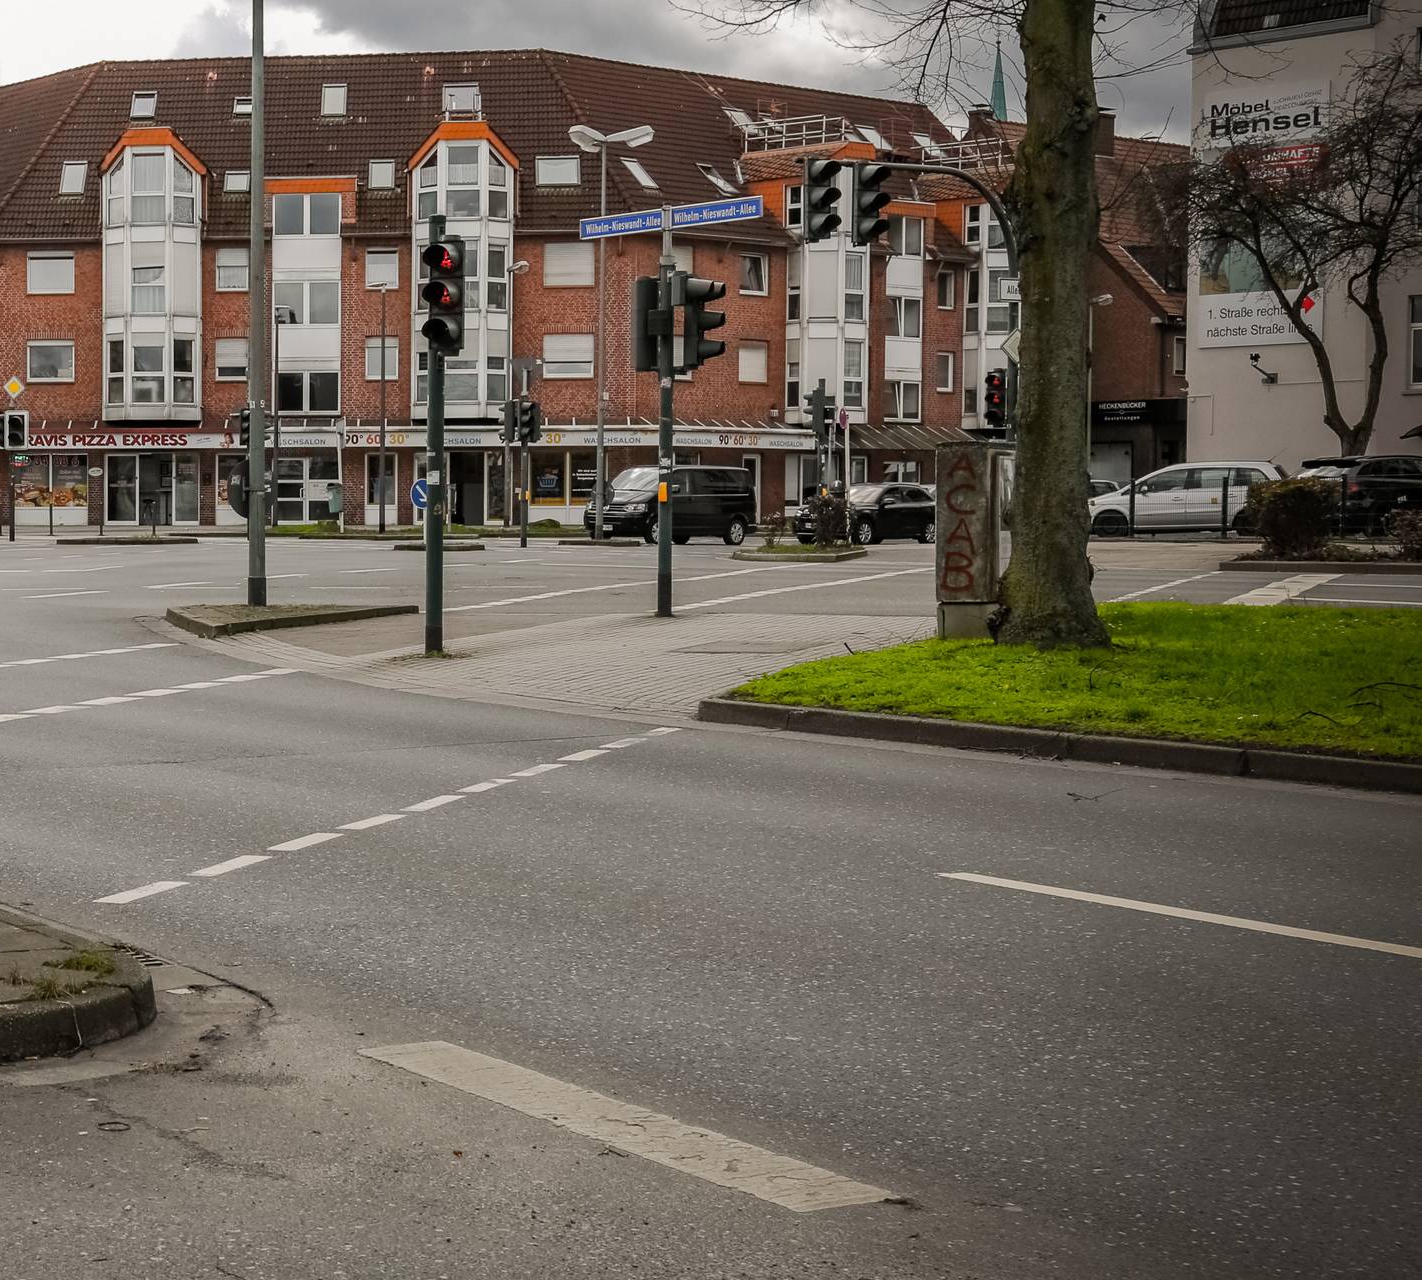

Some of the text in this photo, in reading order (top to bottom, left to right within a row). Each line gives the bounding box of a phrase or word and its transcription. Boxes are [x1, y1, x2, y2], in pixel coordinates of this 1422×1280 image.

[1210, 99, 1270, 117] Möbel
[1210, 106, 1321, 137] Hensel
[673, 204, 756, 223] Wilhelm-Nieswandt-Allee
[585, 217, 661, 234] Wilhelm-Nieswandt-Allee
[1208, 310, 1217, 319] 1.
[1219, 306, 1253, 319] Straße
[1206, 325, 1247, 338] nächste
[1250, 323, 1285, 335] Straße
[27, 434, 67, 447] RAVIS
[72, 434, 117, 447] PIZZA
[122, 434, 188, 447] EXPRESS
[583, 436, 641, 444] WACHSALON
[939, 452, 977, 593] ACAB
